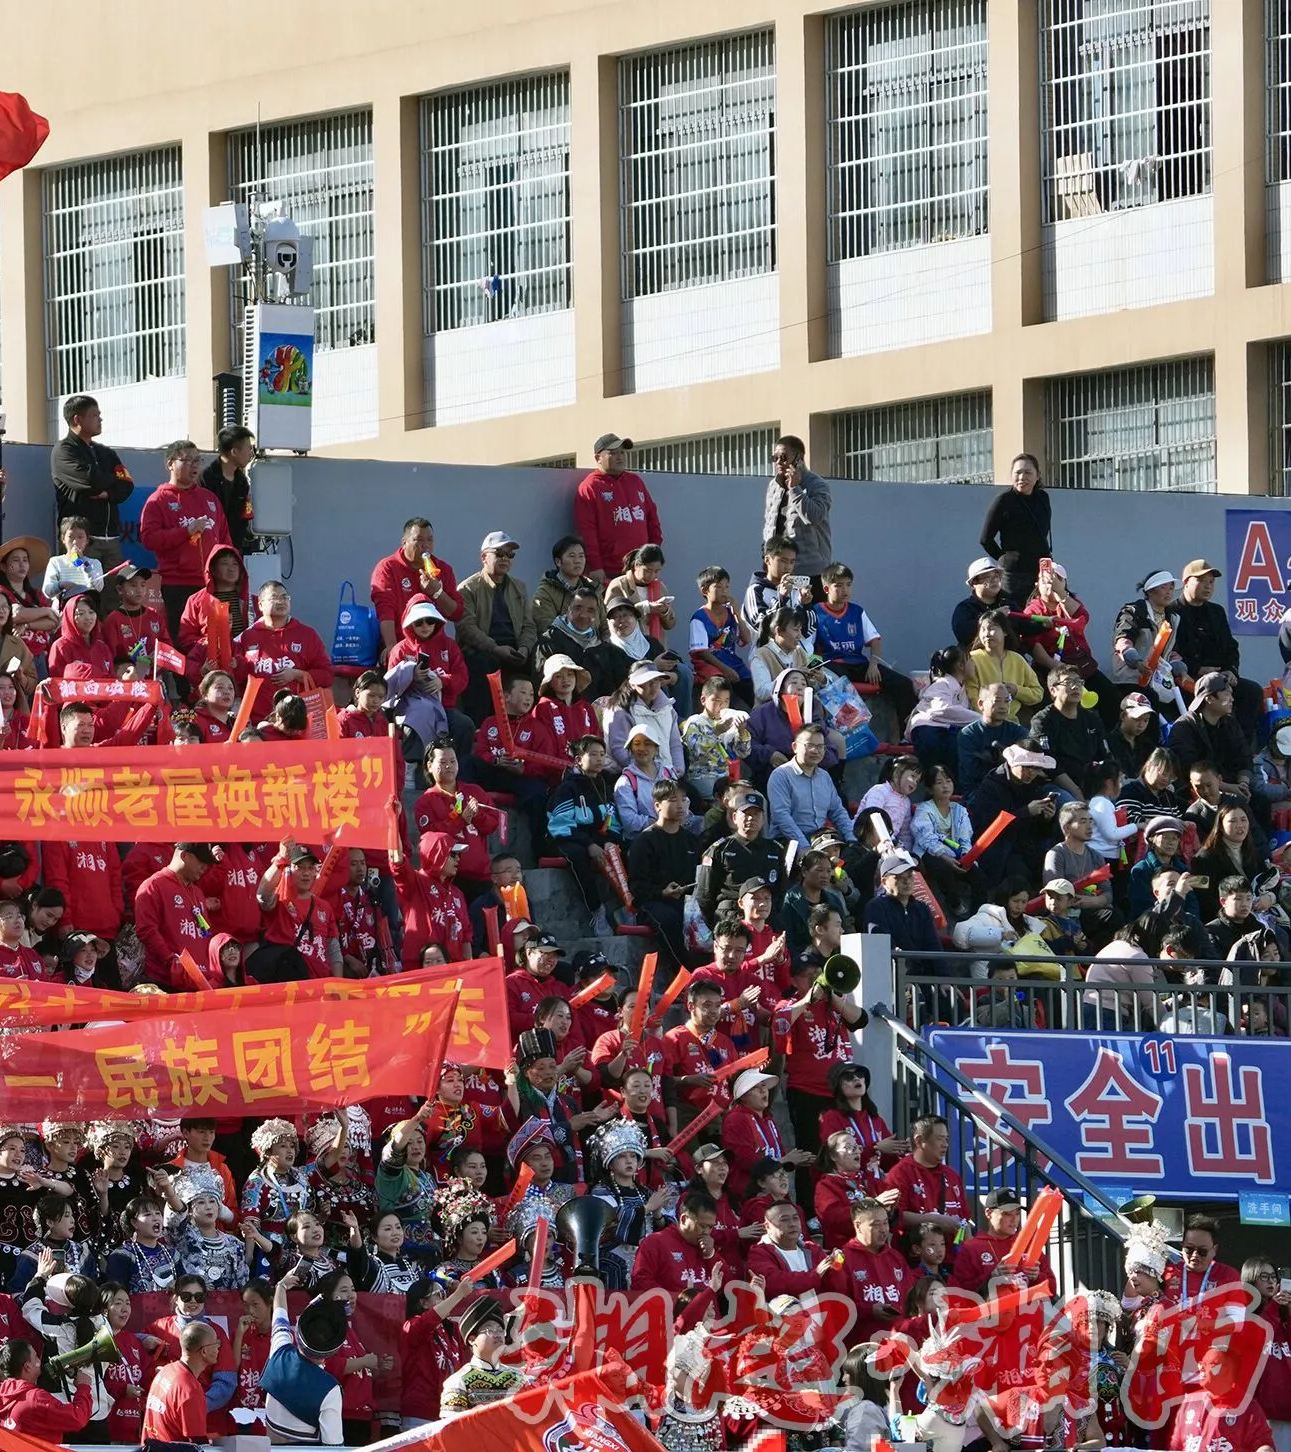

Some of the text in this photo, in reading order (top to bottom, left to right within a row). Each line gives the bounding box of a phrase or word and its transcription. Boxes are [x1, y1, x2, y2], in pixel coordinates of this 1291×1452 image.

[612, 507, 644, 526] 湘西
[251, 656, 294, 675] 湘西
[76, 852, 106, 873] 湘西
[227, 867, 257, 889] 湘西
[1141, 1039, 1177, 1074] 11
[1246, 1201, 1283, 1217] 洗手间
[862, 1284, 900, 1304] 湘西
